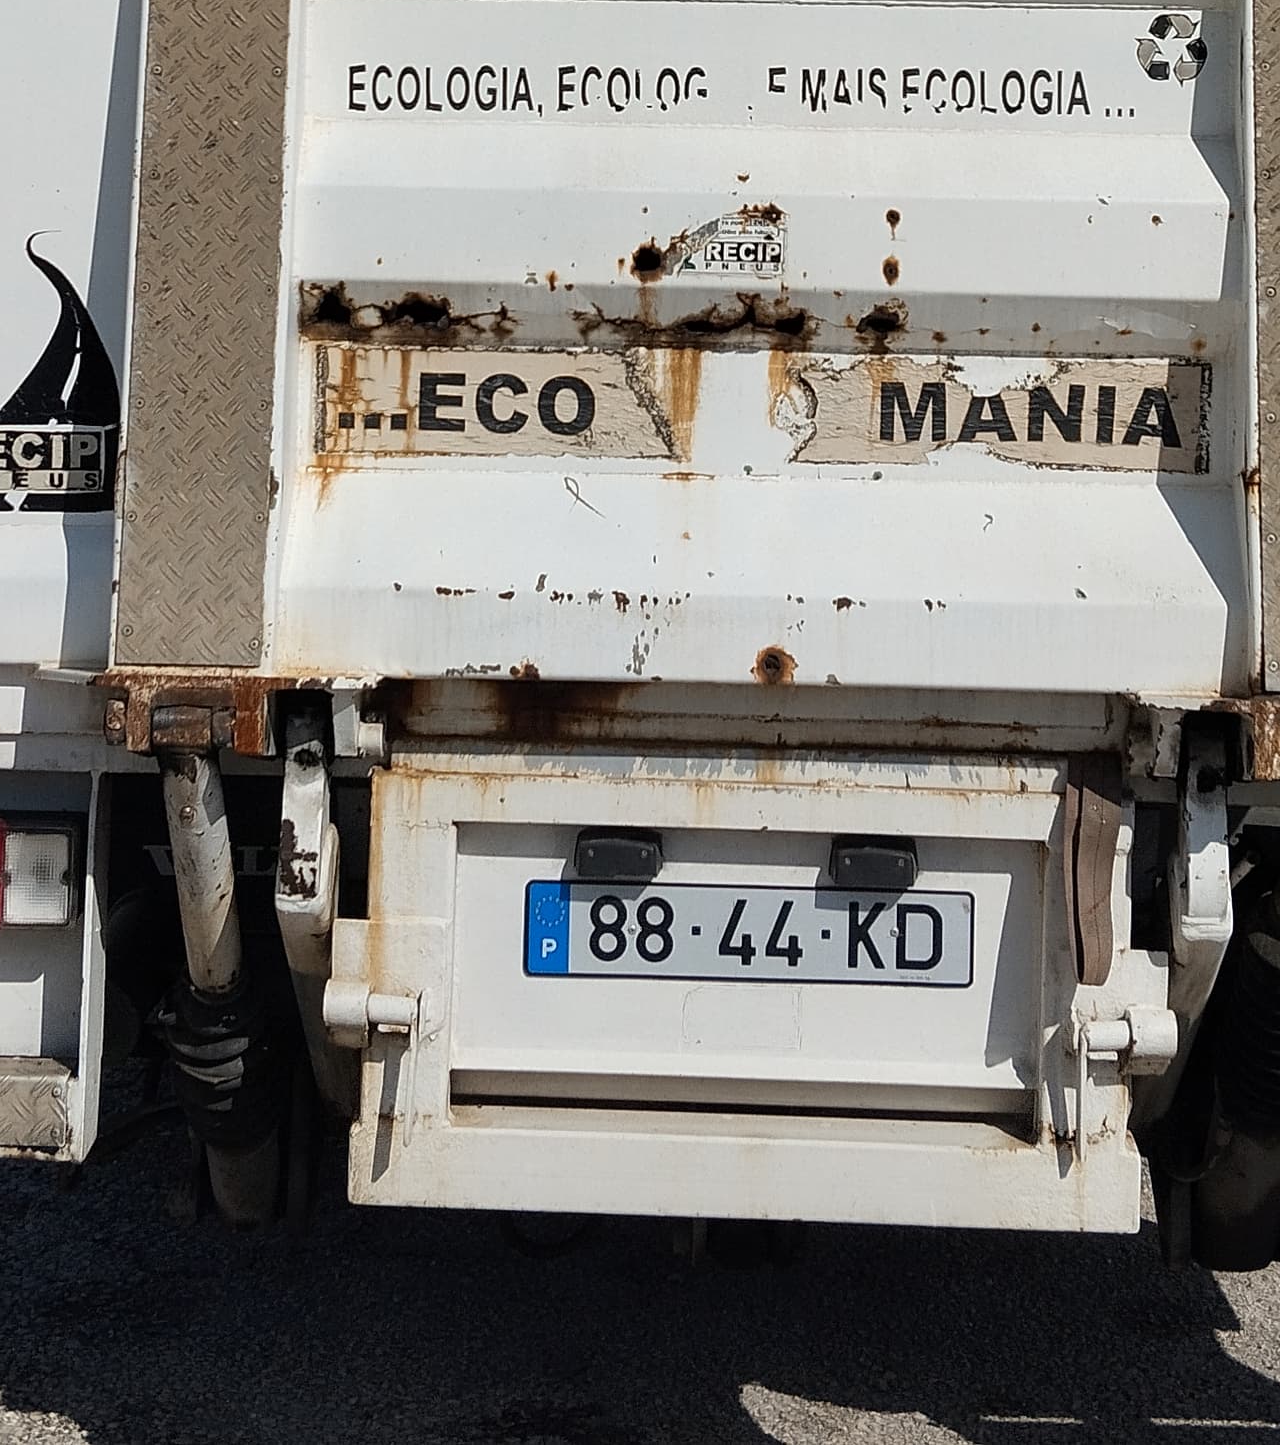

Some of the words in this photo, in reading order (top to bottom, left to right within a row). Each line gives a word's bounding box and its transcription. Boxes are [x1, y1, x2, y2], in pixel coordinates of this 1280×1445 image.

[348, 64, 544, 118] ECOLOGIA,
[802, 68, 887, 113] MAIS
[901, 68, 1091, 115] ECOLOGIA
[705, 242, 782, 262] RECIP
[704, 262, 781, 272] PNEUS
[879, 381, 1183, 448] MANIA
[540, 938, 558, 959] P
